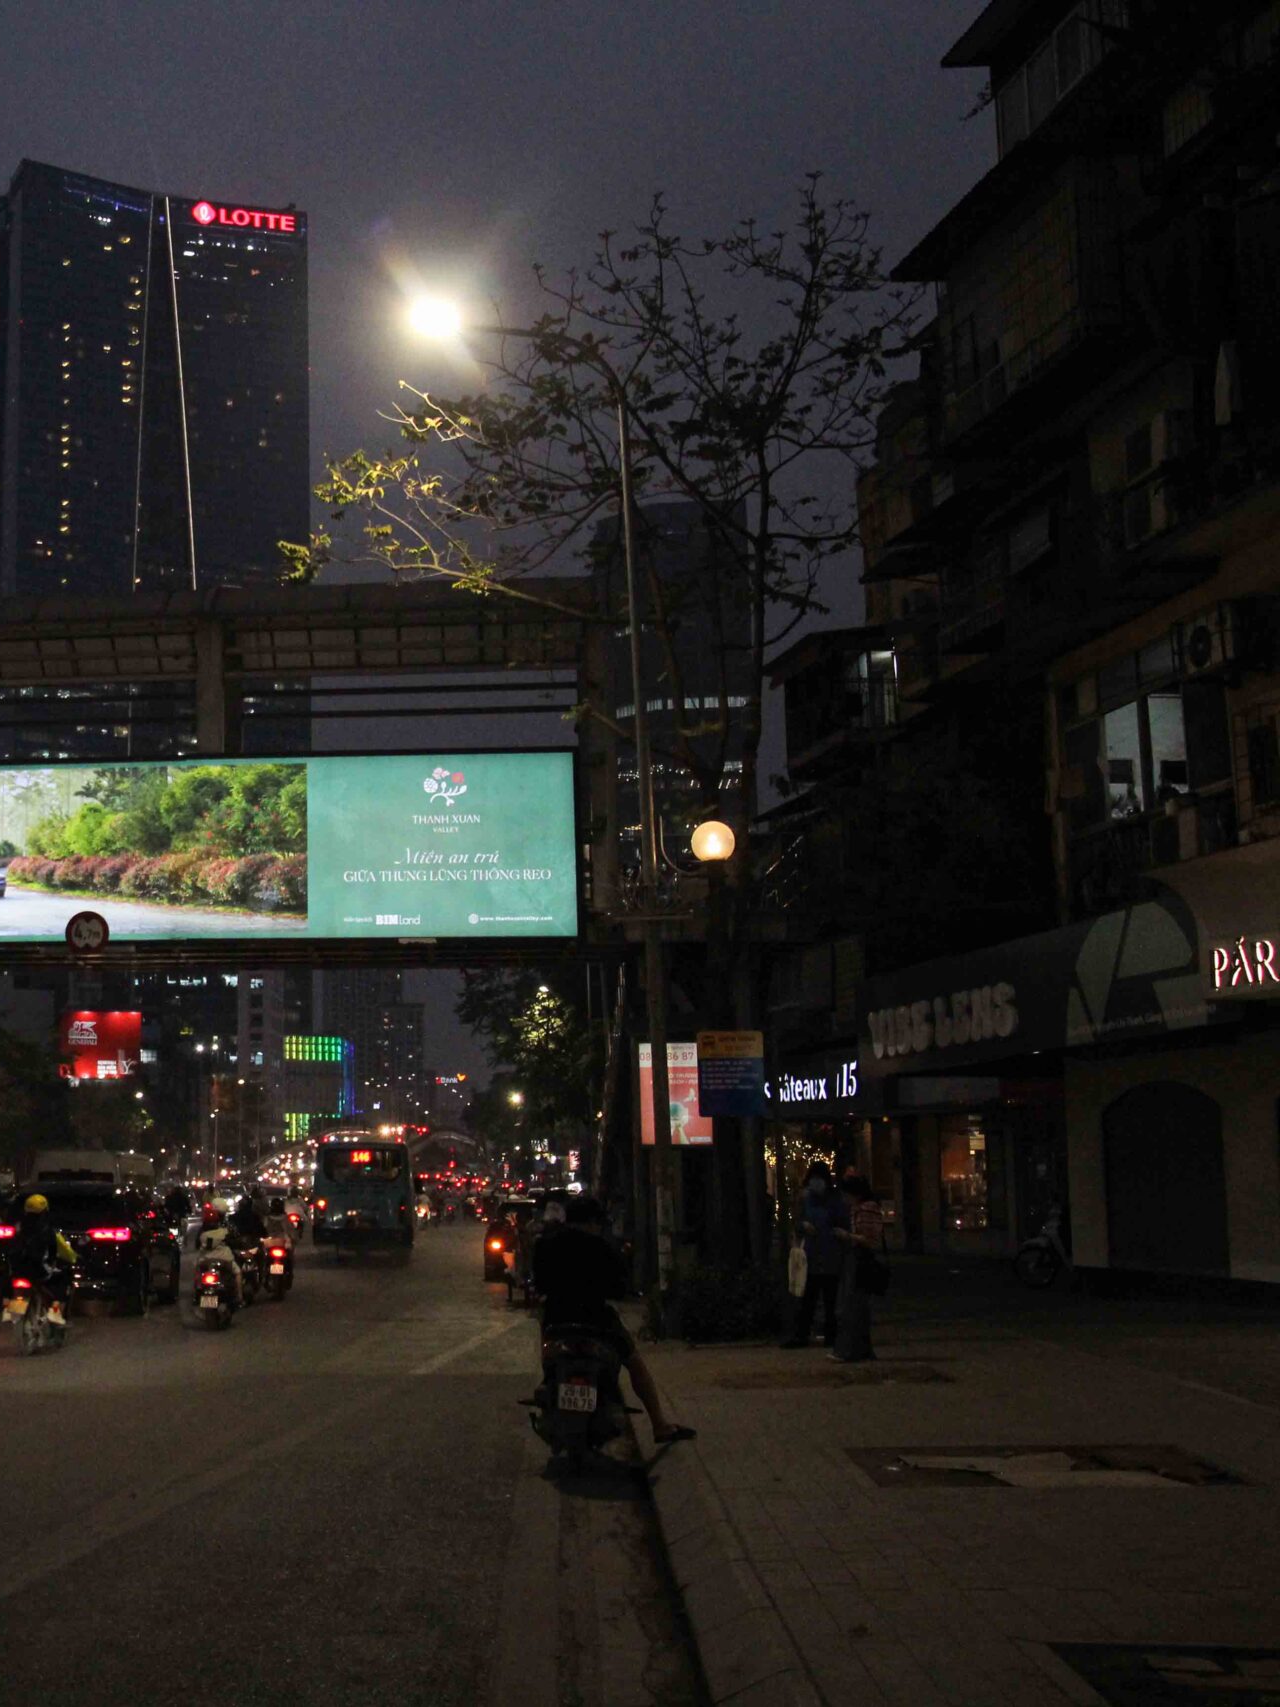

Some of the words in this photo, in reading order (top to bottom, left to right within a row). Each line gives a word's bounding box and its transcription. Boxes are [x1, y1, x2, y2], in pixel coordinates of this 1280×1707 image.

[219, 208, 295, 231] LOTTE
[412, 814, 449, 824] THANH
[449, 852, 468, 864] an
[379, 870, 427, 882] THUNG
[523, 869, 552, 880] REO
[933, 982, 1019, 1048] LENS
[841, 1060, 857, 1098] 15
